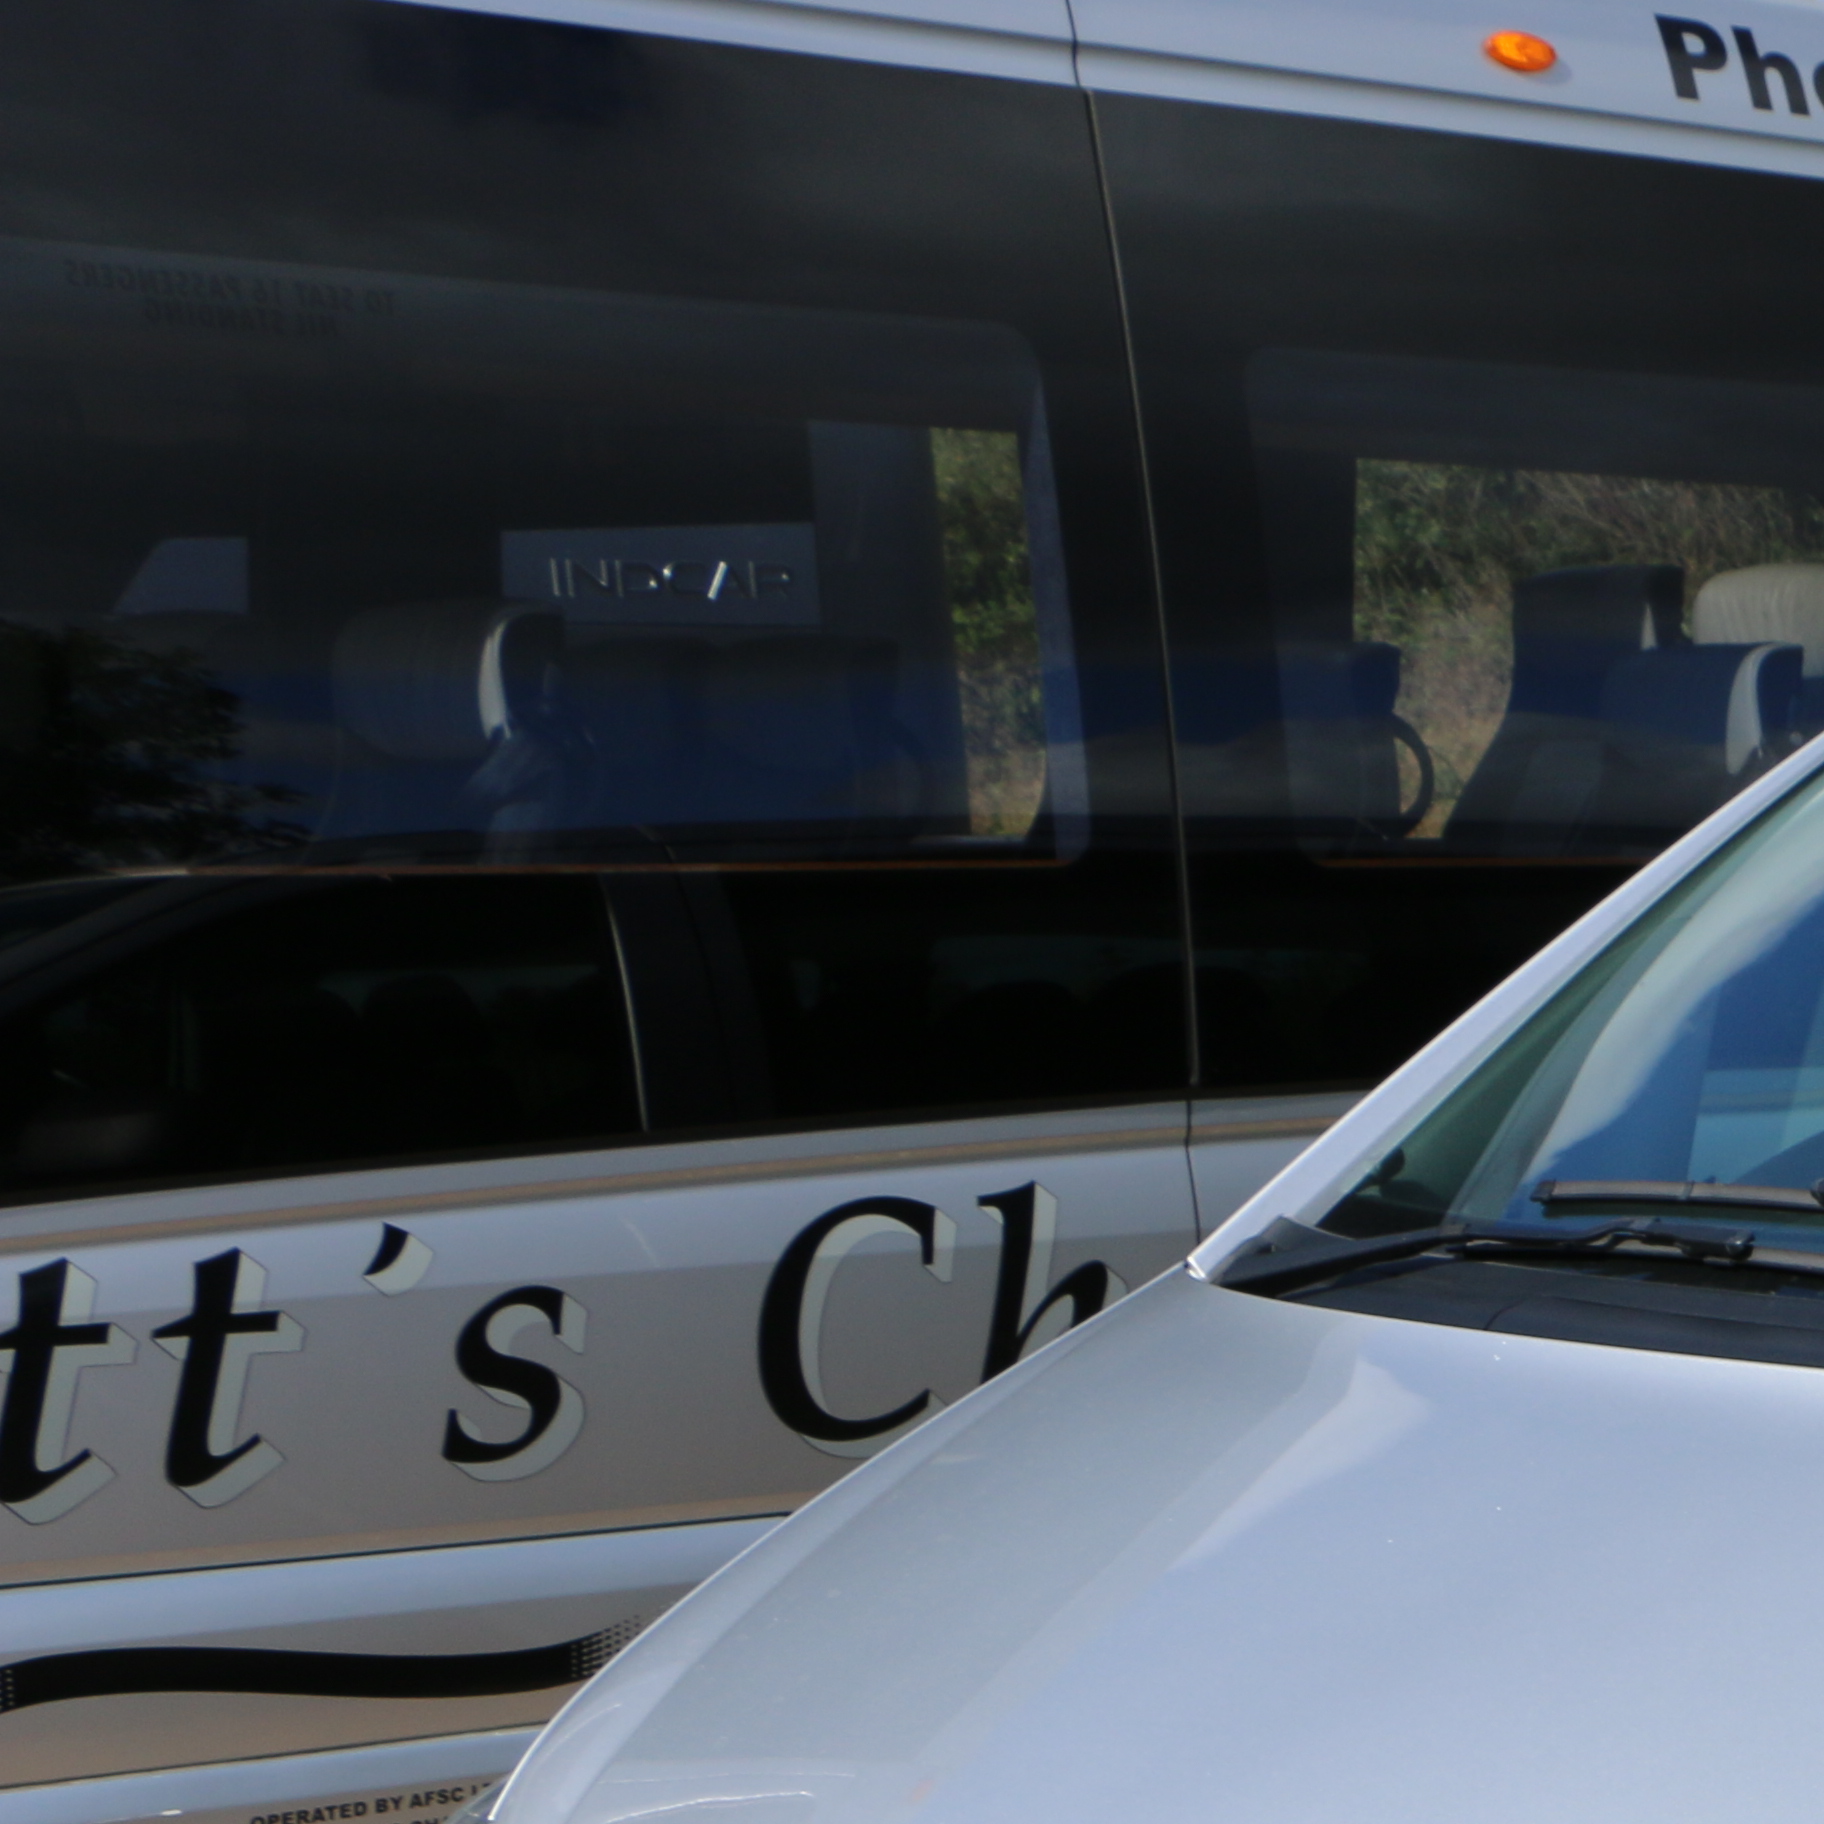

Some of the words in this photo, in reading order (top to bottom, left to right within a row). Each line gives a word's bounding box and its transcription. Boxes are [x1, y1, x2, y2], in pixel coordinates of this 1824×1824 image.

[549, 556, 794, 602] INDCAR
[375, 1796, 403, 1813] BY
[409, 1787, 464, 1808] AFSC
